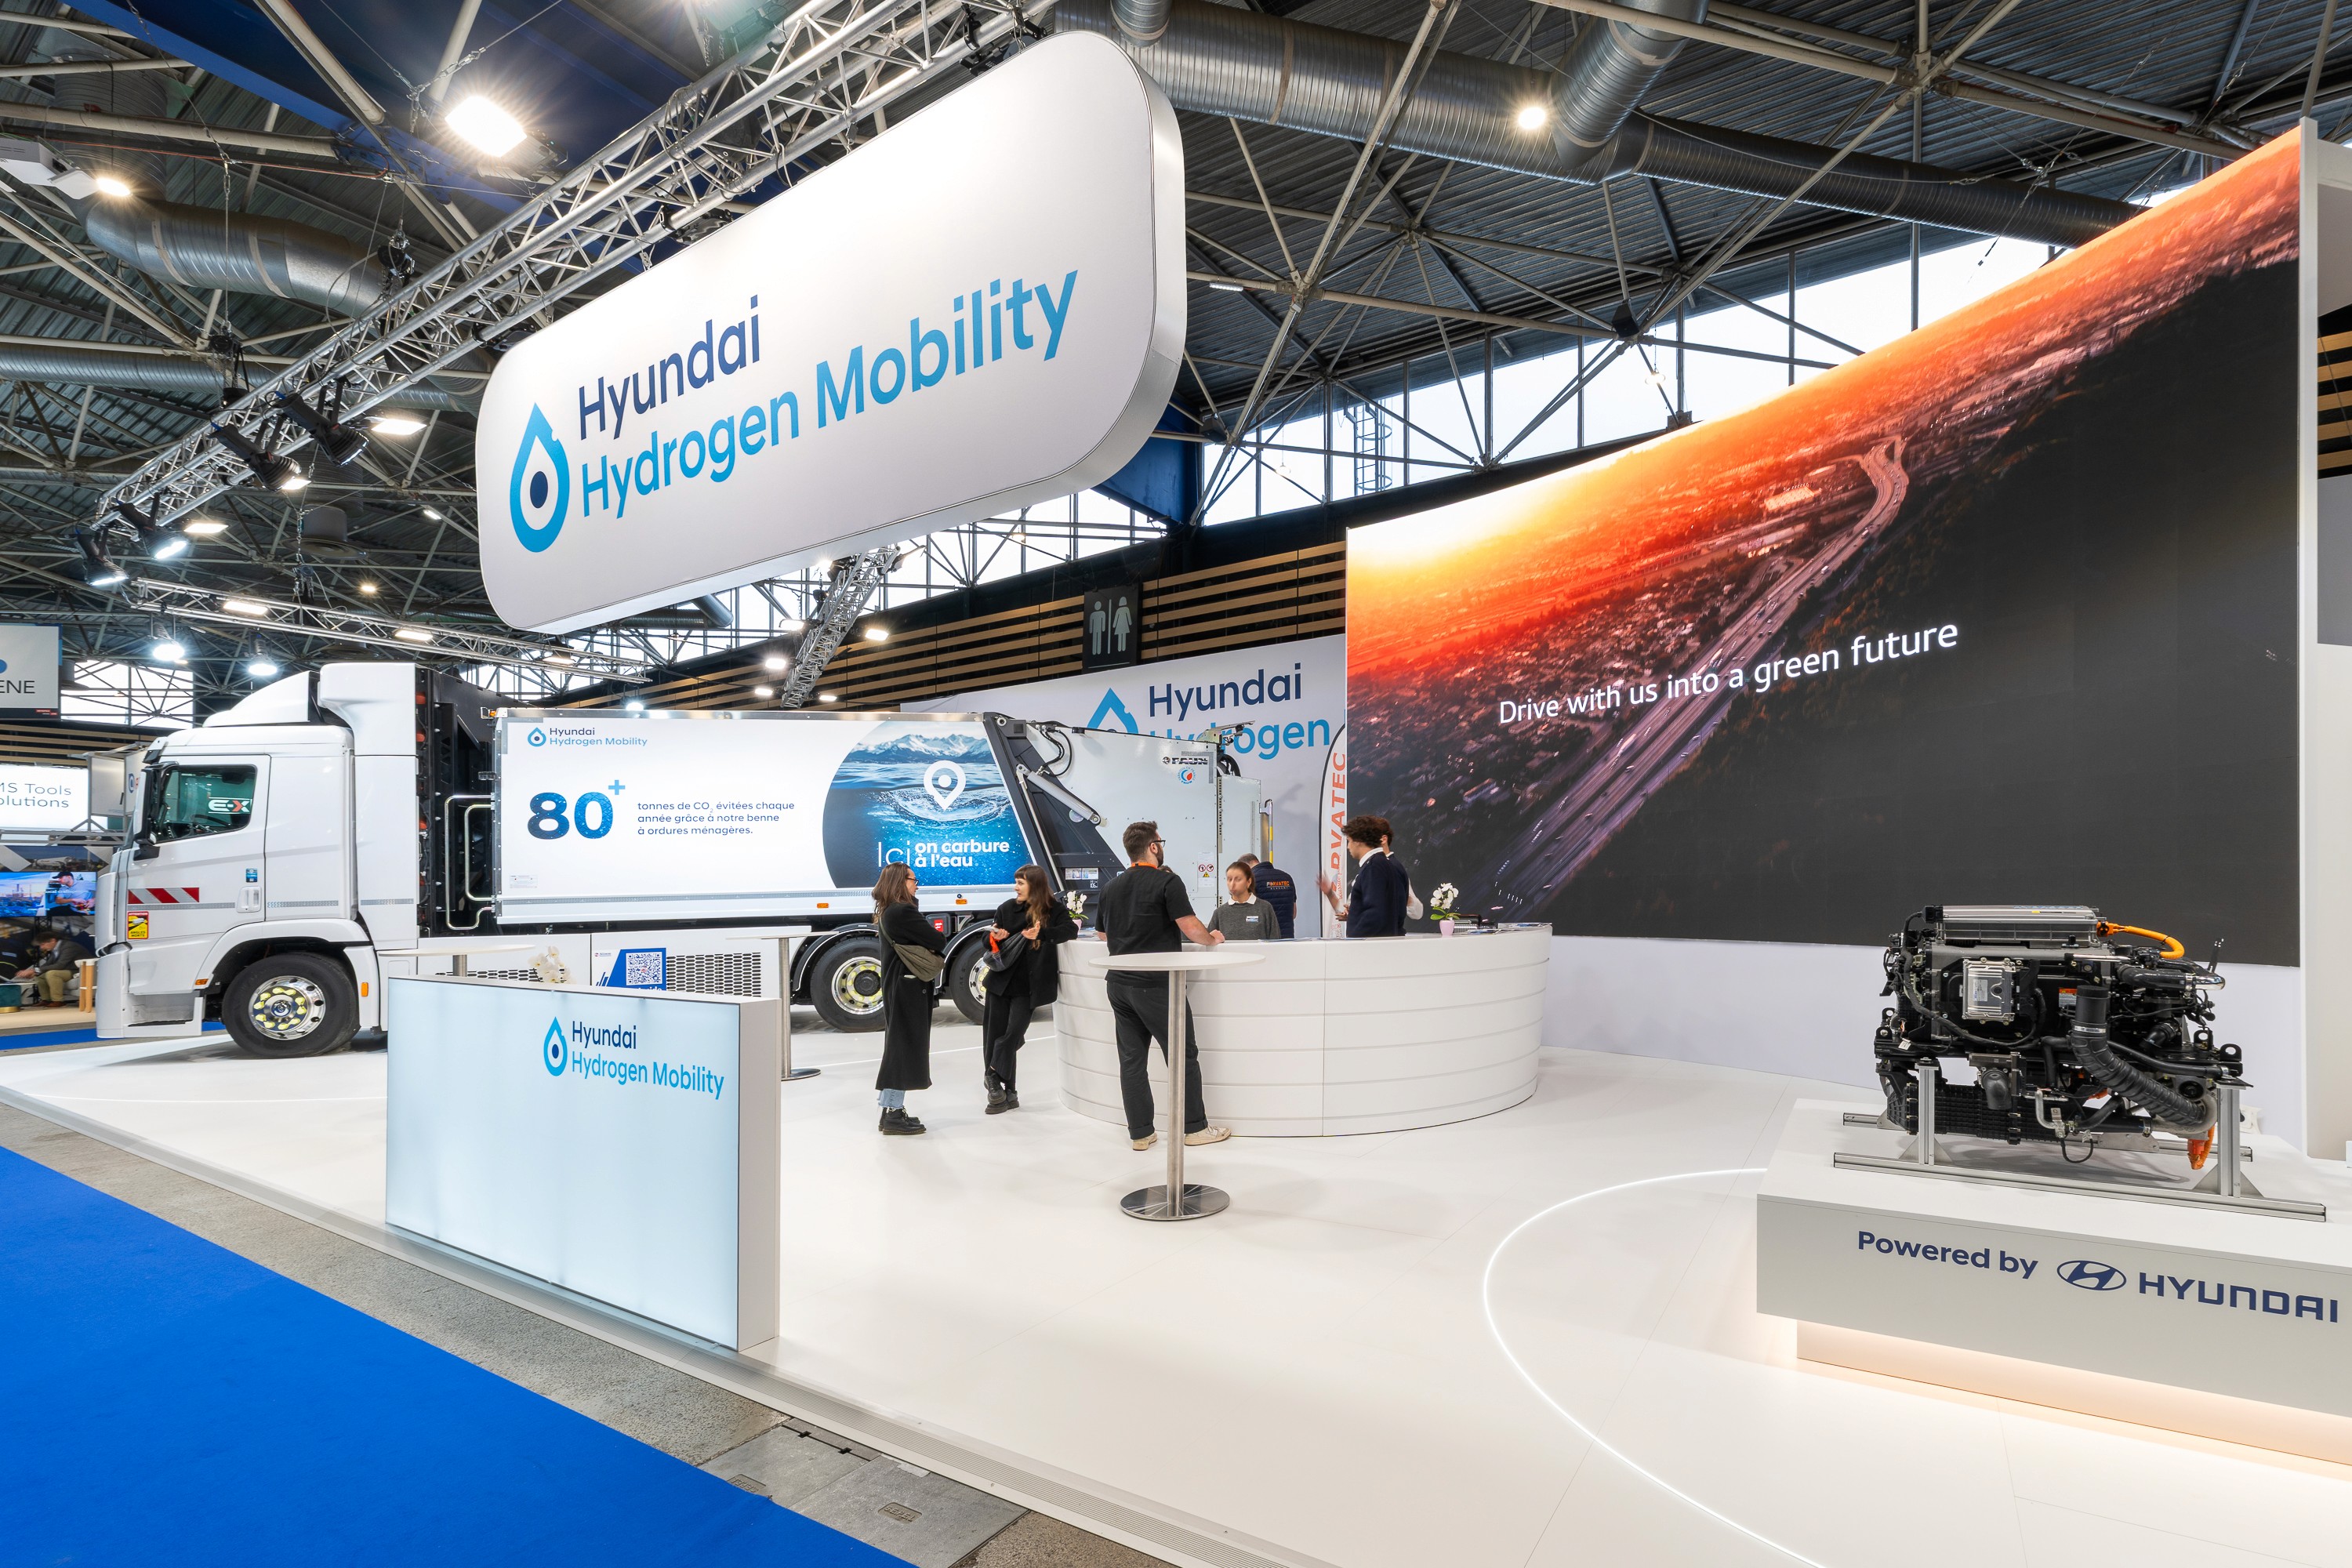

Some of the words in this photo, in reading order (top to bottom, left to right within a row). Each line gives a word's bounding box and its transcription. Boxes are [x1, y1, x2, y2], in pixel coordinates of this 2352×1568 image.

[579, 295, 761, 440] Hyundai
[582, 391, 800, 519] Hydrogen
[817, 270, 1080, 430] Mobility
[1500, 700, 1559, 724] Drive
[1566, 685, 1621, 714] with
[1630, 684, 1658, 705] us
[1667, 670, 1719, 699] into
[1729, 668, 1744, 688] a
[1754, 649, 1839, 693] green
[1850, 624, 1958, 666] future
[1149, 662, 1301, 722] Hyundai
[550, 728, 595, 737] Hyundai
[550, 737, 603, 747] Hydrogen
[605, 737, 648, 747] Mobility
[1149, 719, 1330, 760] rogen
[25, 783, 71, 796] Tools
[637, 801, 675, 811] tonnes
[677, 801, 691, 810] de
[716, 801, 753, 810] évitées
[756, 801, 795, 811] chaque
[637, 814, 672, 822] année
[674, 813, 705, 824] grâce
[707, 813, 714, 822] à
[747, 813, 779, 822] benne
[637, 826, 644, 835] à
[648, 826, 688, 835] ordures
[691, 826, 753, 836] ménagères.
[878, 840, 910, 867] Ici
[915, 842, 938, 854] on
[941, 839, 1010, 853] carbure
[915, 854, 927, 867] à
[572, 1020, 637, 1050] Hyundai
[572, 1051, 648, 1086] Hydrogen
[652, 1061, 725, 1100] Mobility
[1858, 1230, 1991, 1269] Powered
[1999, 1250, 2039, 1279] by
[2139, 1272, 2339, 1323] HYUNDAI
